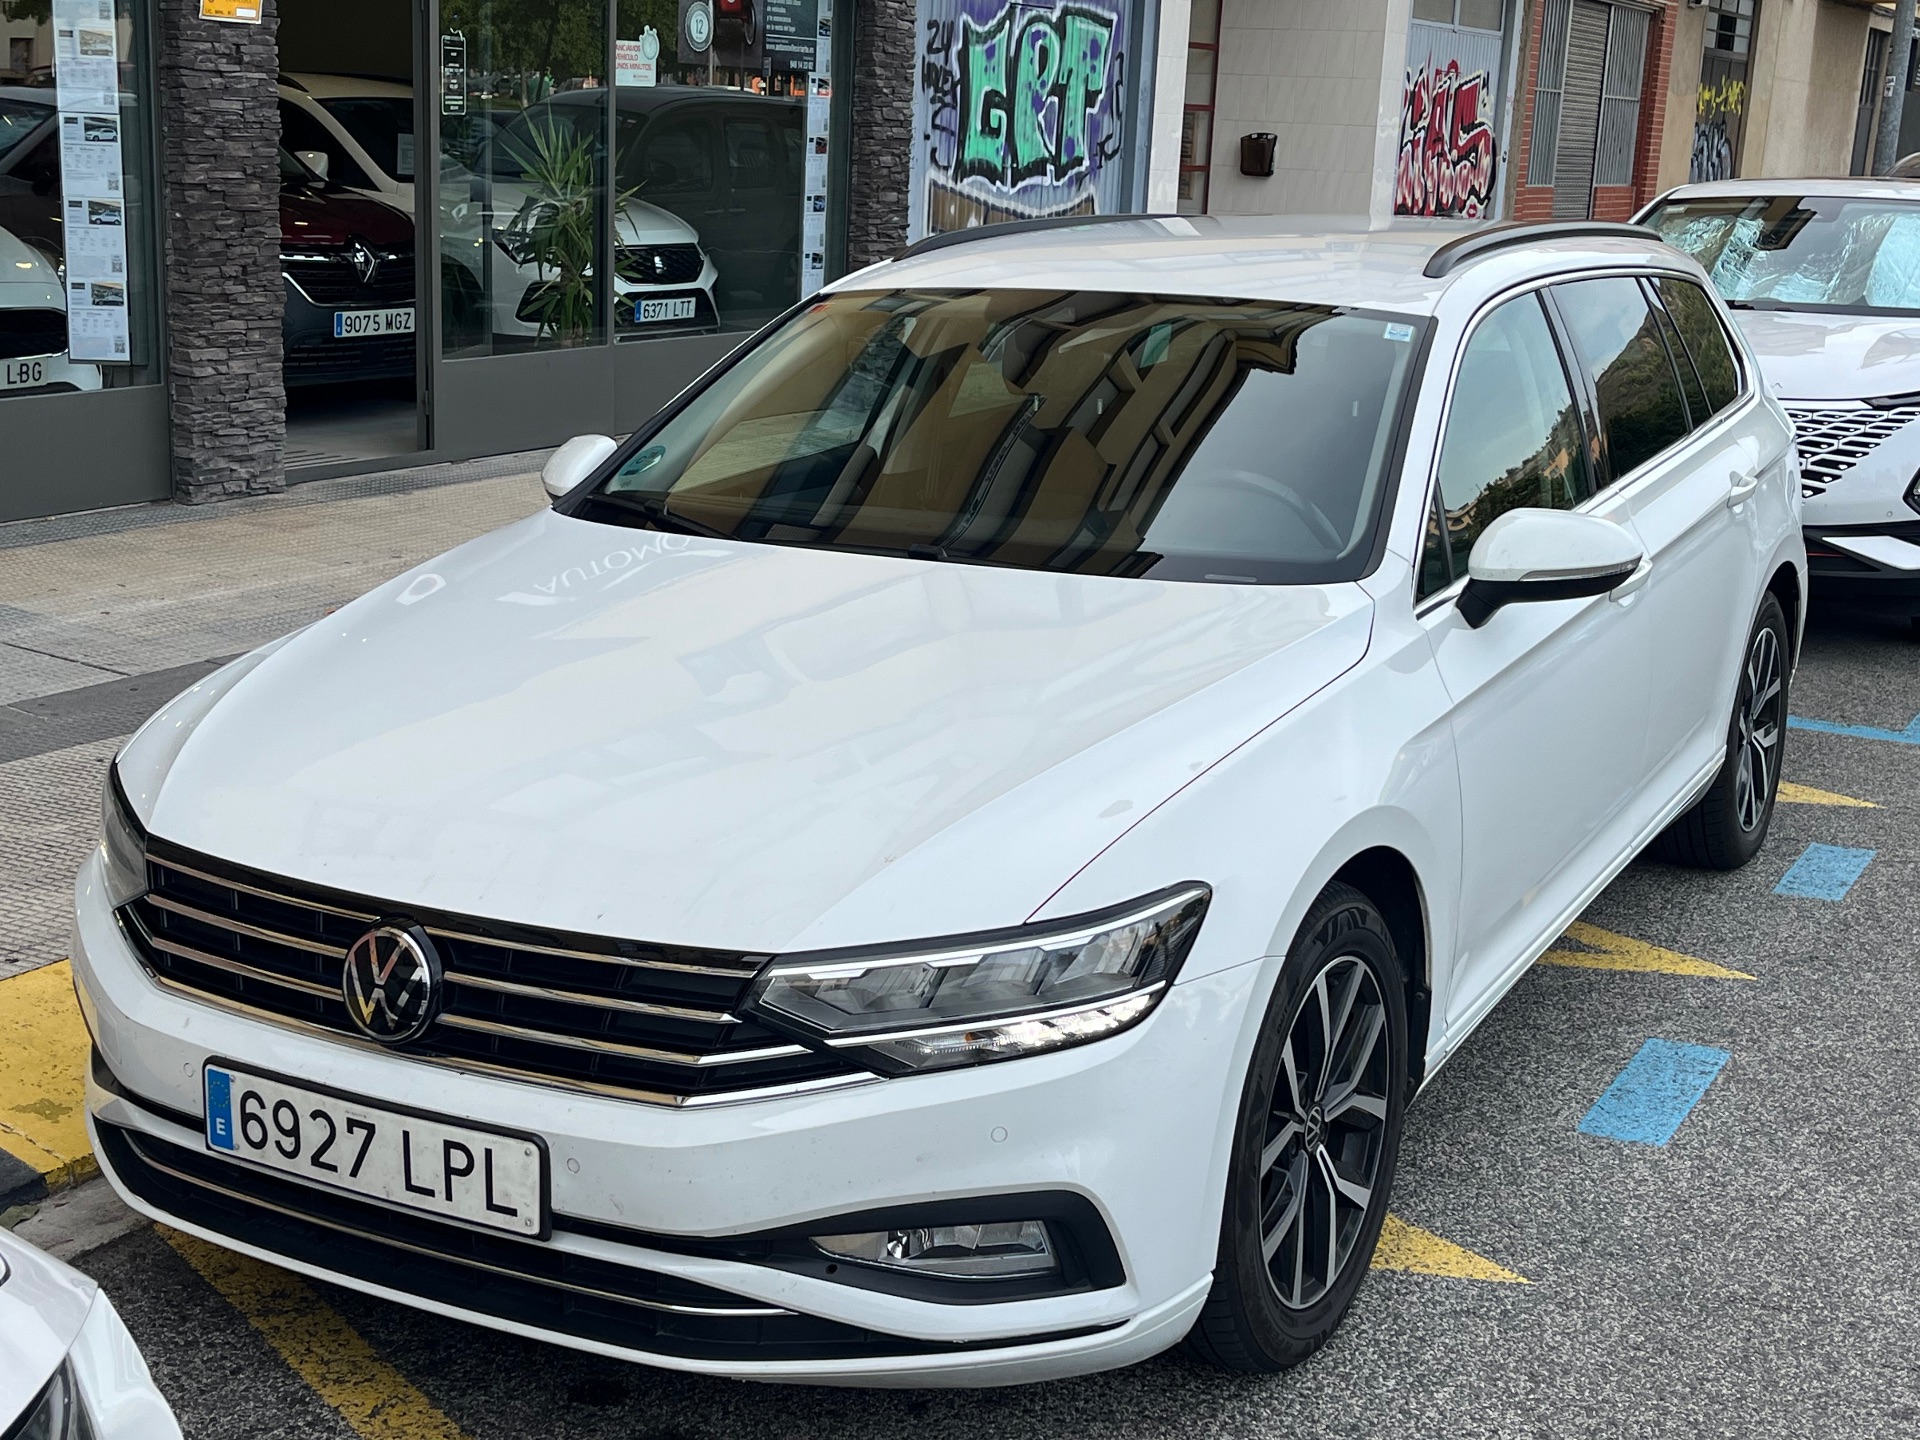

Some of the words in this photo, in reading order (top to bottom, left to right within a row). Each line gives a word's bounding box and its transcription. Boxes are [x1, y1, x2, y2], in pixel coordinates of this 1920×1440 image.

[695, 18, 704, 35] 12
[614, 43, 641, 52] ANCIAMOS
[643, 302, 669, 319] 6371
[673, 300, 692, 317] LTT
[344, 314, 380, 334] 9075
[385, 312, 412, 331] MGZ
[7, 362, 42, 385] LBG
[216, 1117, 227, 1136] E
[239, 1089, 377, 1179] 6927
[402, 1129, 519, 1218] LPL
